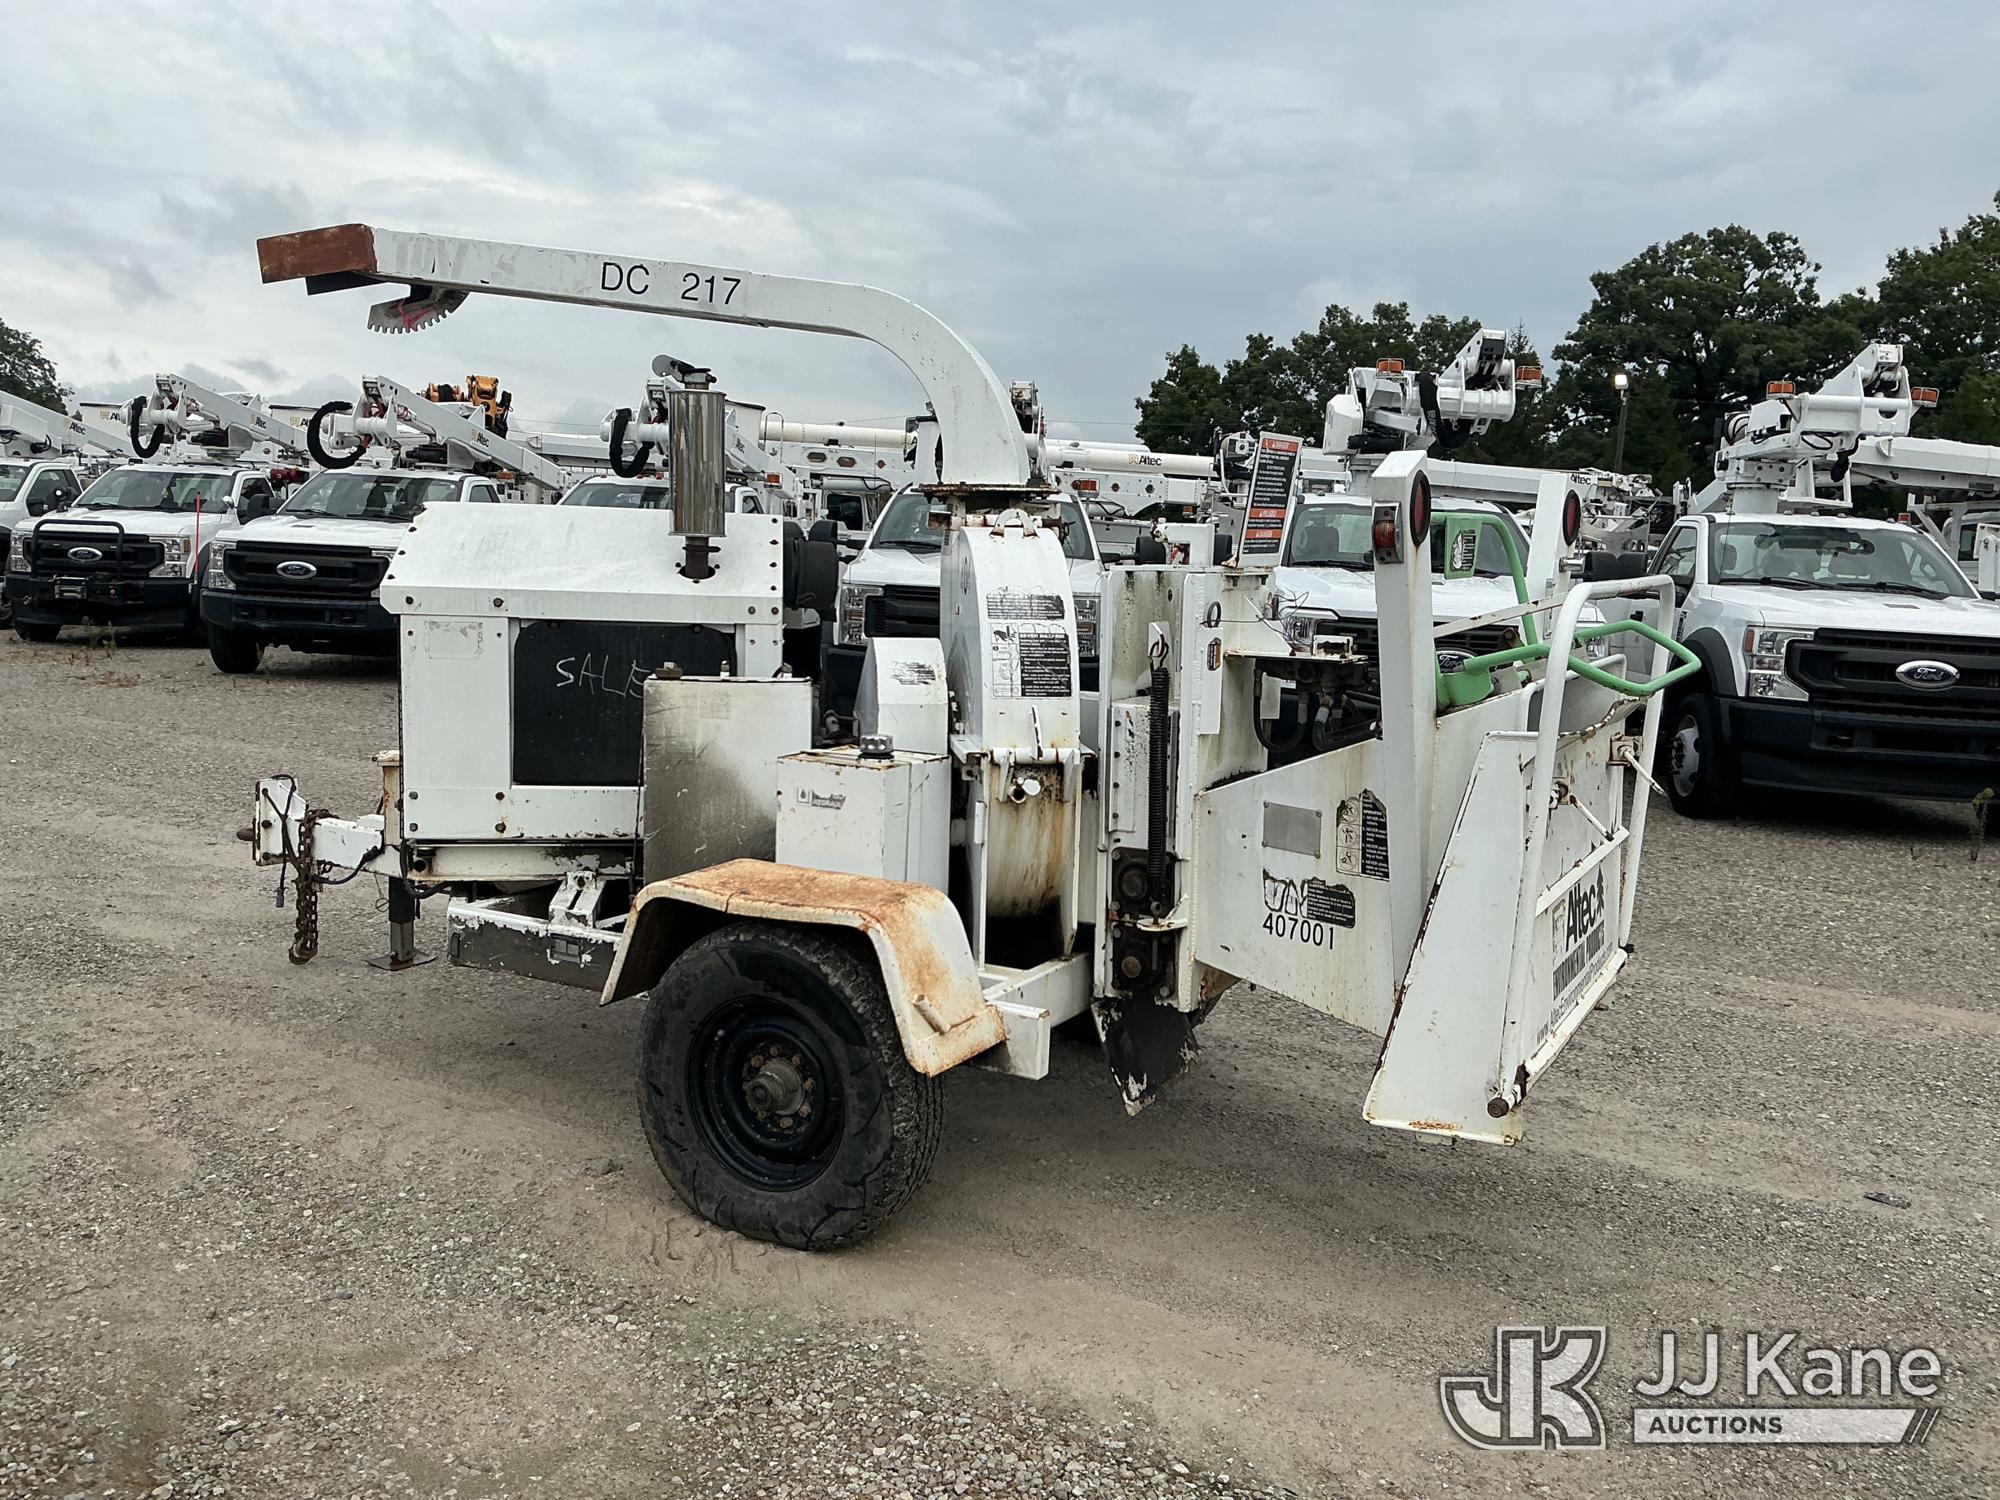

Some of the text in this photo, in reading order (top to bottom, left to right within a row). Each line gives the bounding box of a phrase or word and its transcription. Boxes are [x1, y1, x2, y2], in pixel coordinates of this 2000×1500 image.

[601, 261, 742, 305] DC 217
[69, 421, 86, 435] Altec
[1138, 455, 1162, 466] Altec
[1570, 473, 1591, 486] Altec
[556, 652, 651, 698] SALE
[1914, 667, 1946, 682] Ford
[1566, 882, 1596, 952] Altec
[1263, 913, 1334, 950] 407001
